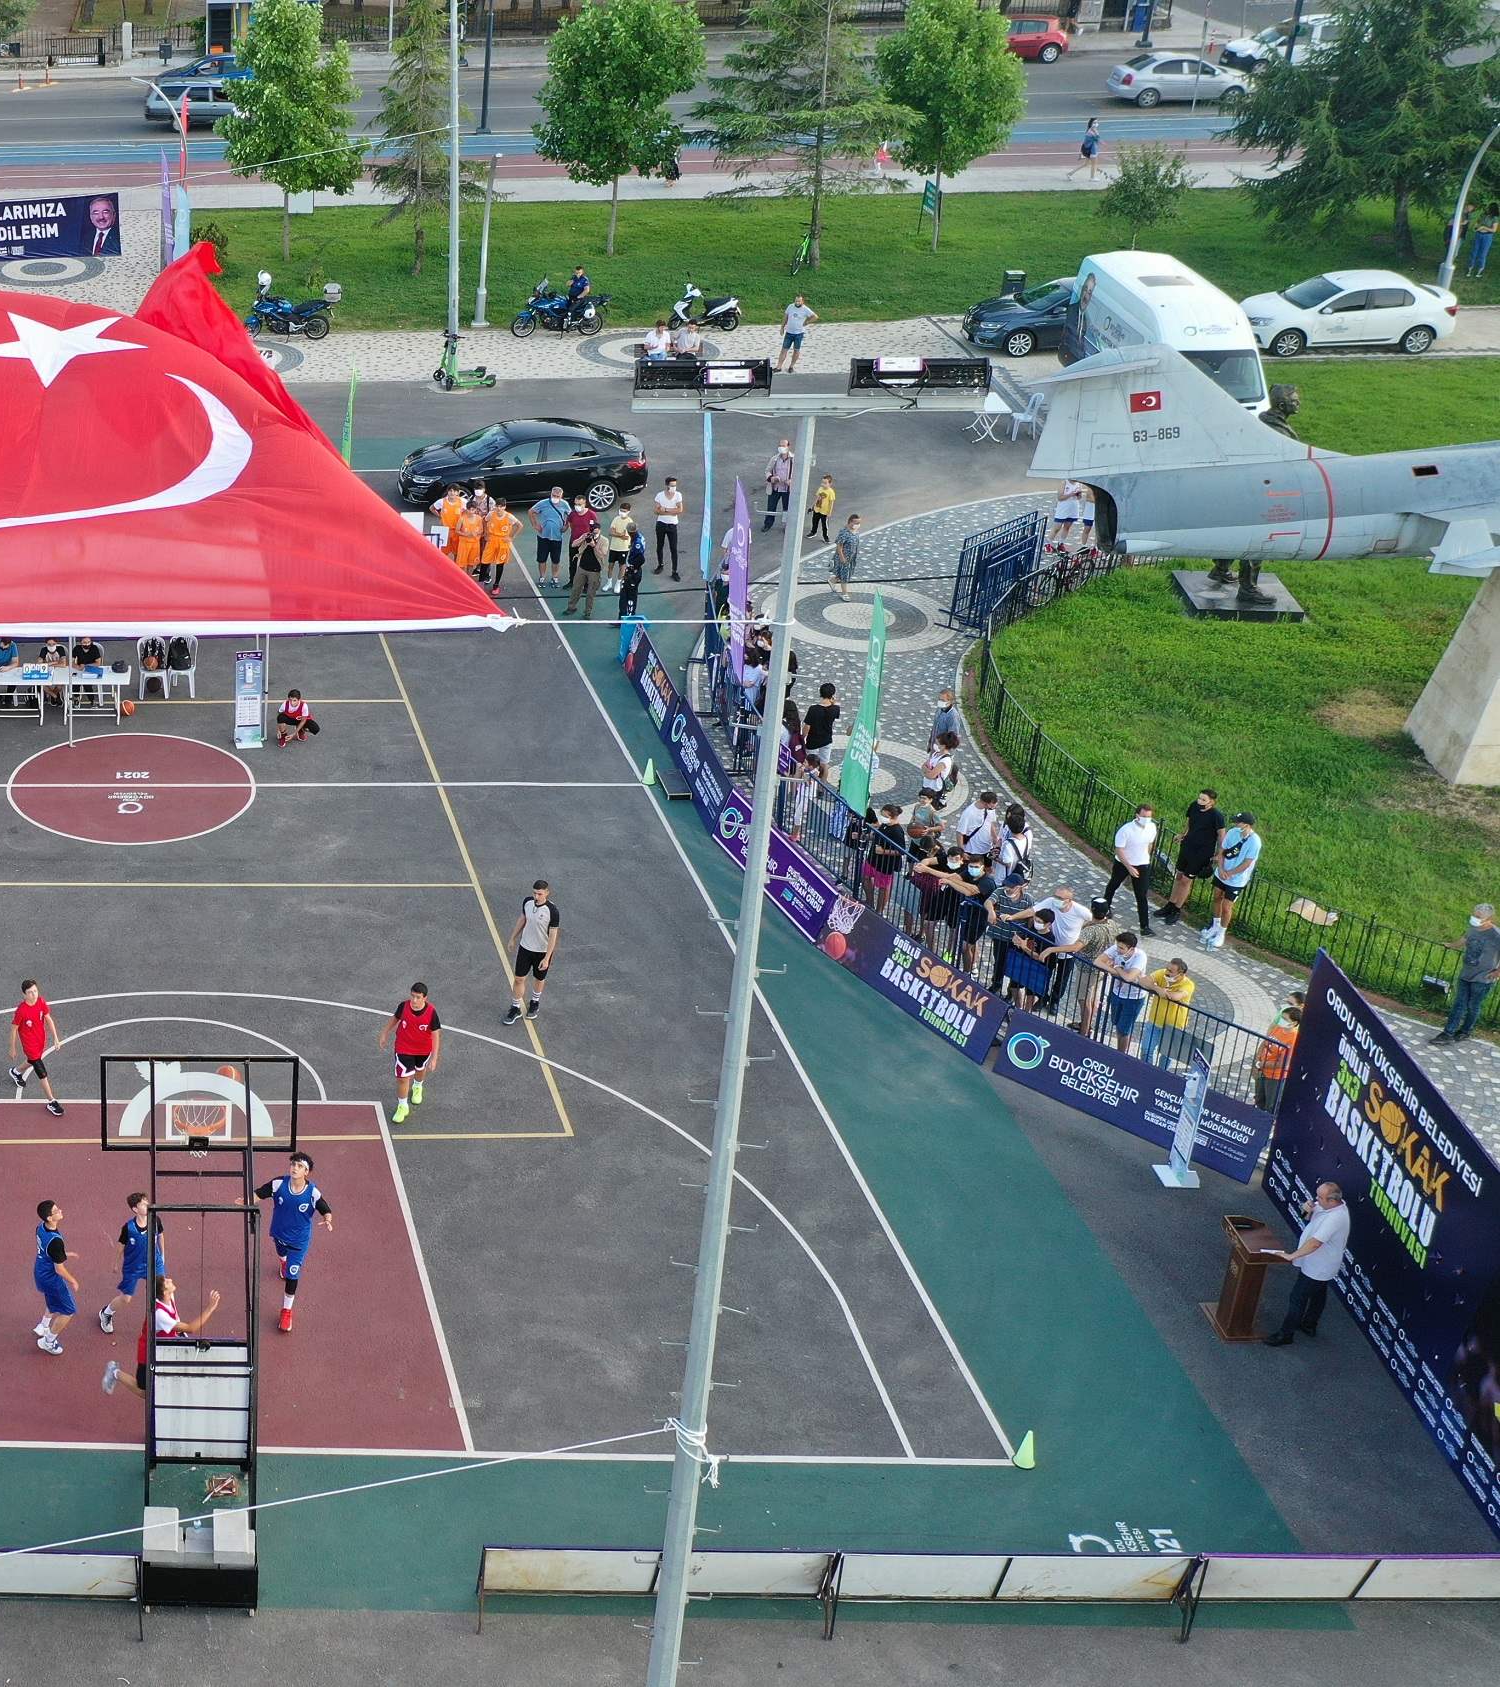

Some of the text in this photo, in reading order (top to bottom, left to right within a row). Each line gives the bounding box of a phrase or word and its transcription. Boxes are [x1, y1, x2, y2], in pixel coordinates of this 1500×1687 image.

[1133, 426, 1181, 444] 63-869
[115, 771, 150, 779] 2021
[805, 892, 822, 912] ORDU
[880, 957, 977, 1036] BASKETBOLU
[916, 957, 989, 1018] SOKAK
[1082, 1057, 1115, 1077] ORDU
[1326, 988, 1483, 1198] ORDU BÜYÜKŞEHİR BELEDİYESİ
[1154, 1088, 1184, 1106] GENÇLİ
[1210, 1111, 1222, 1121] VE
[1220, 1113, 1256, 1137] SAĞLIKLI
[1324, 1078, 1437, 1248] BASKETBOLU
[1365, 1081, 1450, 1213] SOKAK
[1369, 1177, 1428, 1270] TURNUVASI
